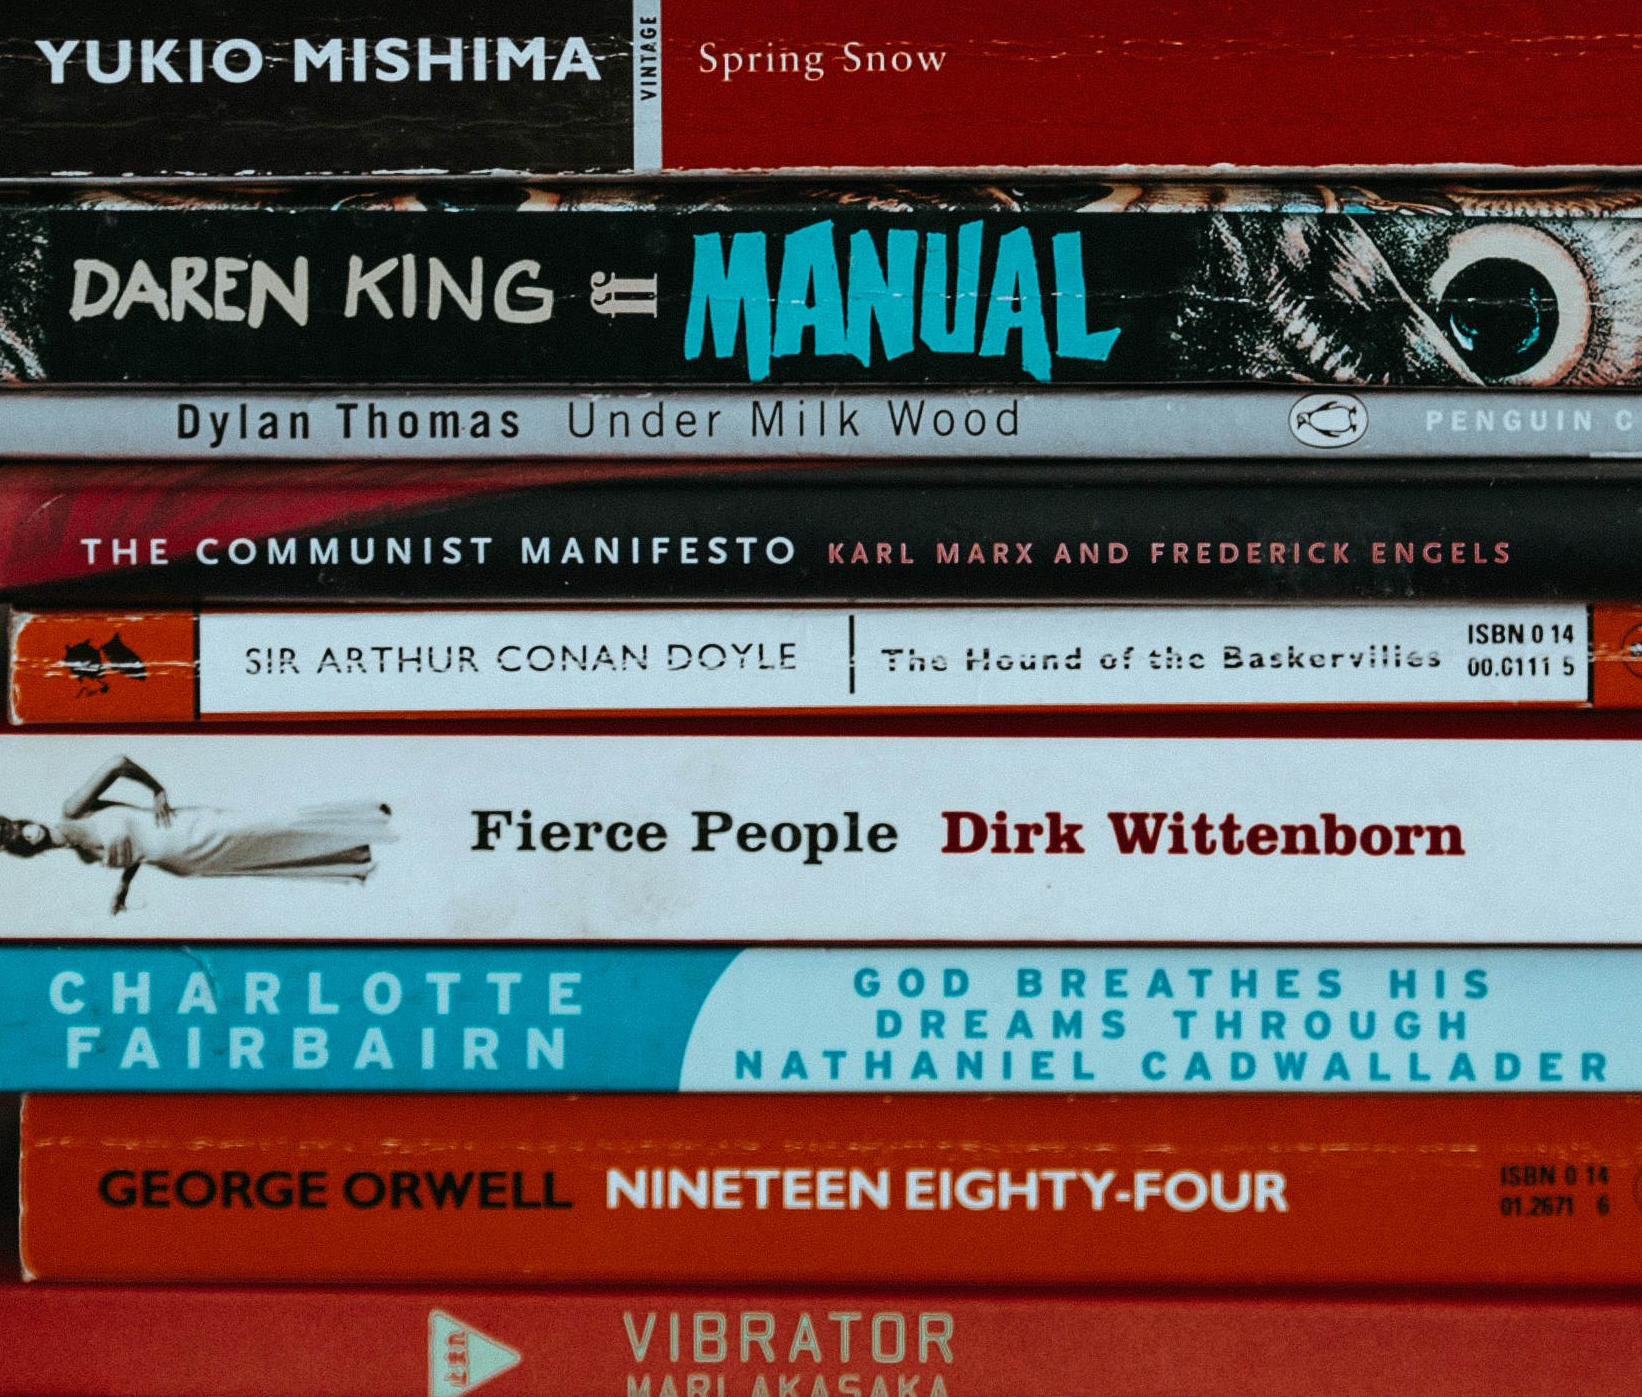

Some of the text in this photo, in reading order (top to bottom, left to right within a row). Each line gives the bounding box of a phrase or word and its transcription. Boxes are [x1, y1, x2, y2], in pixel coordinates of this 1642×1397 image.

[36, 37, 601, 85] YUKIO MISHIMA
[640, 17, 657, 100] VINTAGE
[699, 41, 947, 82] Spring Snow
[69, 254, 555, 329] DAREN KING
[684, 220, 1122, 383] MANUAL
[179, 400, 1020, 448] Dylan Thomas Under Milk Wood
[1425, 409, 1591, 432] PENGUIN
[81, 536, 795, 566] THE COMMUNIST MANIFESTO
[828, 541, 1509, 564] KARL MARX AND FREDERICK ENGELS
[1468, 623, 1574, 645] ISBN 0 14
[471, 809, 898, 865] Fierce People
[941, 810, 1465, 856] Dirk Wittenborn
[49, 970, 582, 1015] CHARLOTTE
[853, 967, 1488, 999] GOD BREATHES HIS
[876, 1009, 1466, 1041] DREAMS THROUGH
[67, 1026, 564, 1069] FAIRBAIRN
[735, 1050, 1606, 1082] NATHANIEL CADWALLADER
[98, 1169, 1287, 1212] GEORGE ORWELL NINETEEN EIGHTY-FOUR
